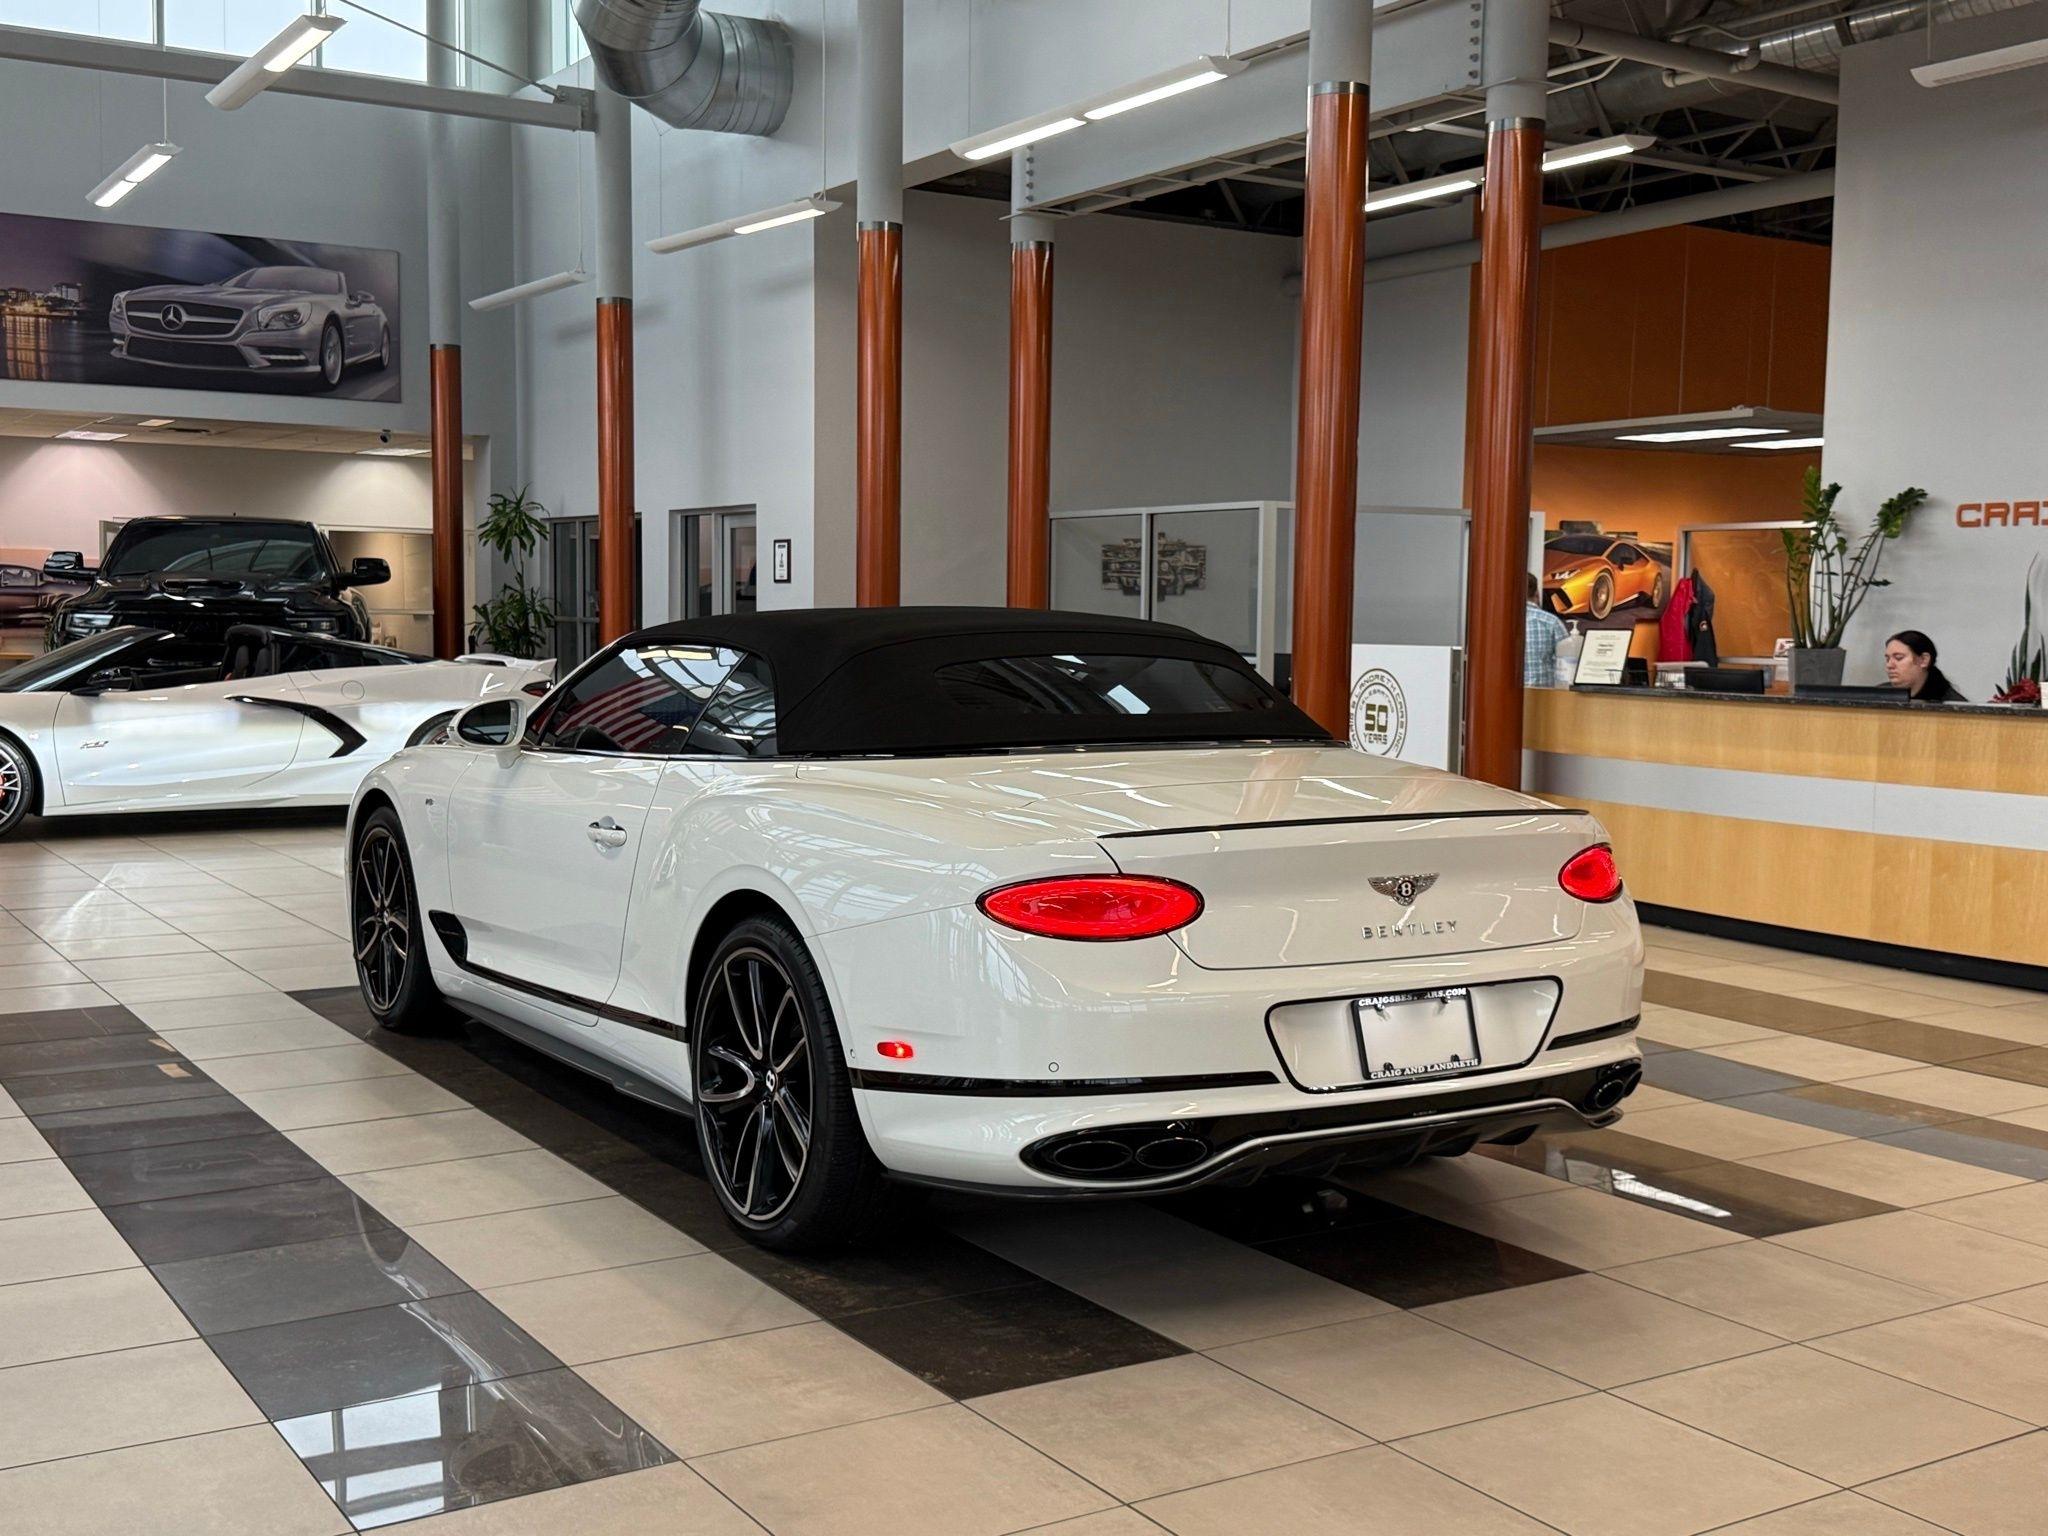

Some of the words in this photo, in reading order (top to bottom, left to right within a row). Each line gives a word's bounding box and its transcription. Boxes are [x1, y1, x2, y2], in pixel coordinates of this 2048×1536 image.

[1364, 703, 1389, 734] 50
[1362, 732, 1388, 746] YEARS
[1361, 919, 1457, 940] BENTLEY
[1358, 987, 1468, 1007] CRAIGSBESARS.COM
[1370, 1068, 1402, 1080] CRAIG
[1403, 1064, 1426, 1076] AND
[1427, 1057, 1479, 1073] LANDRETH
